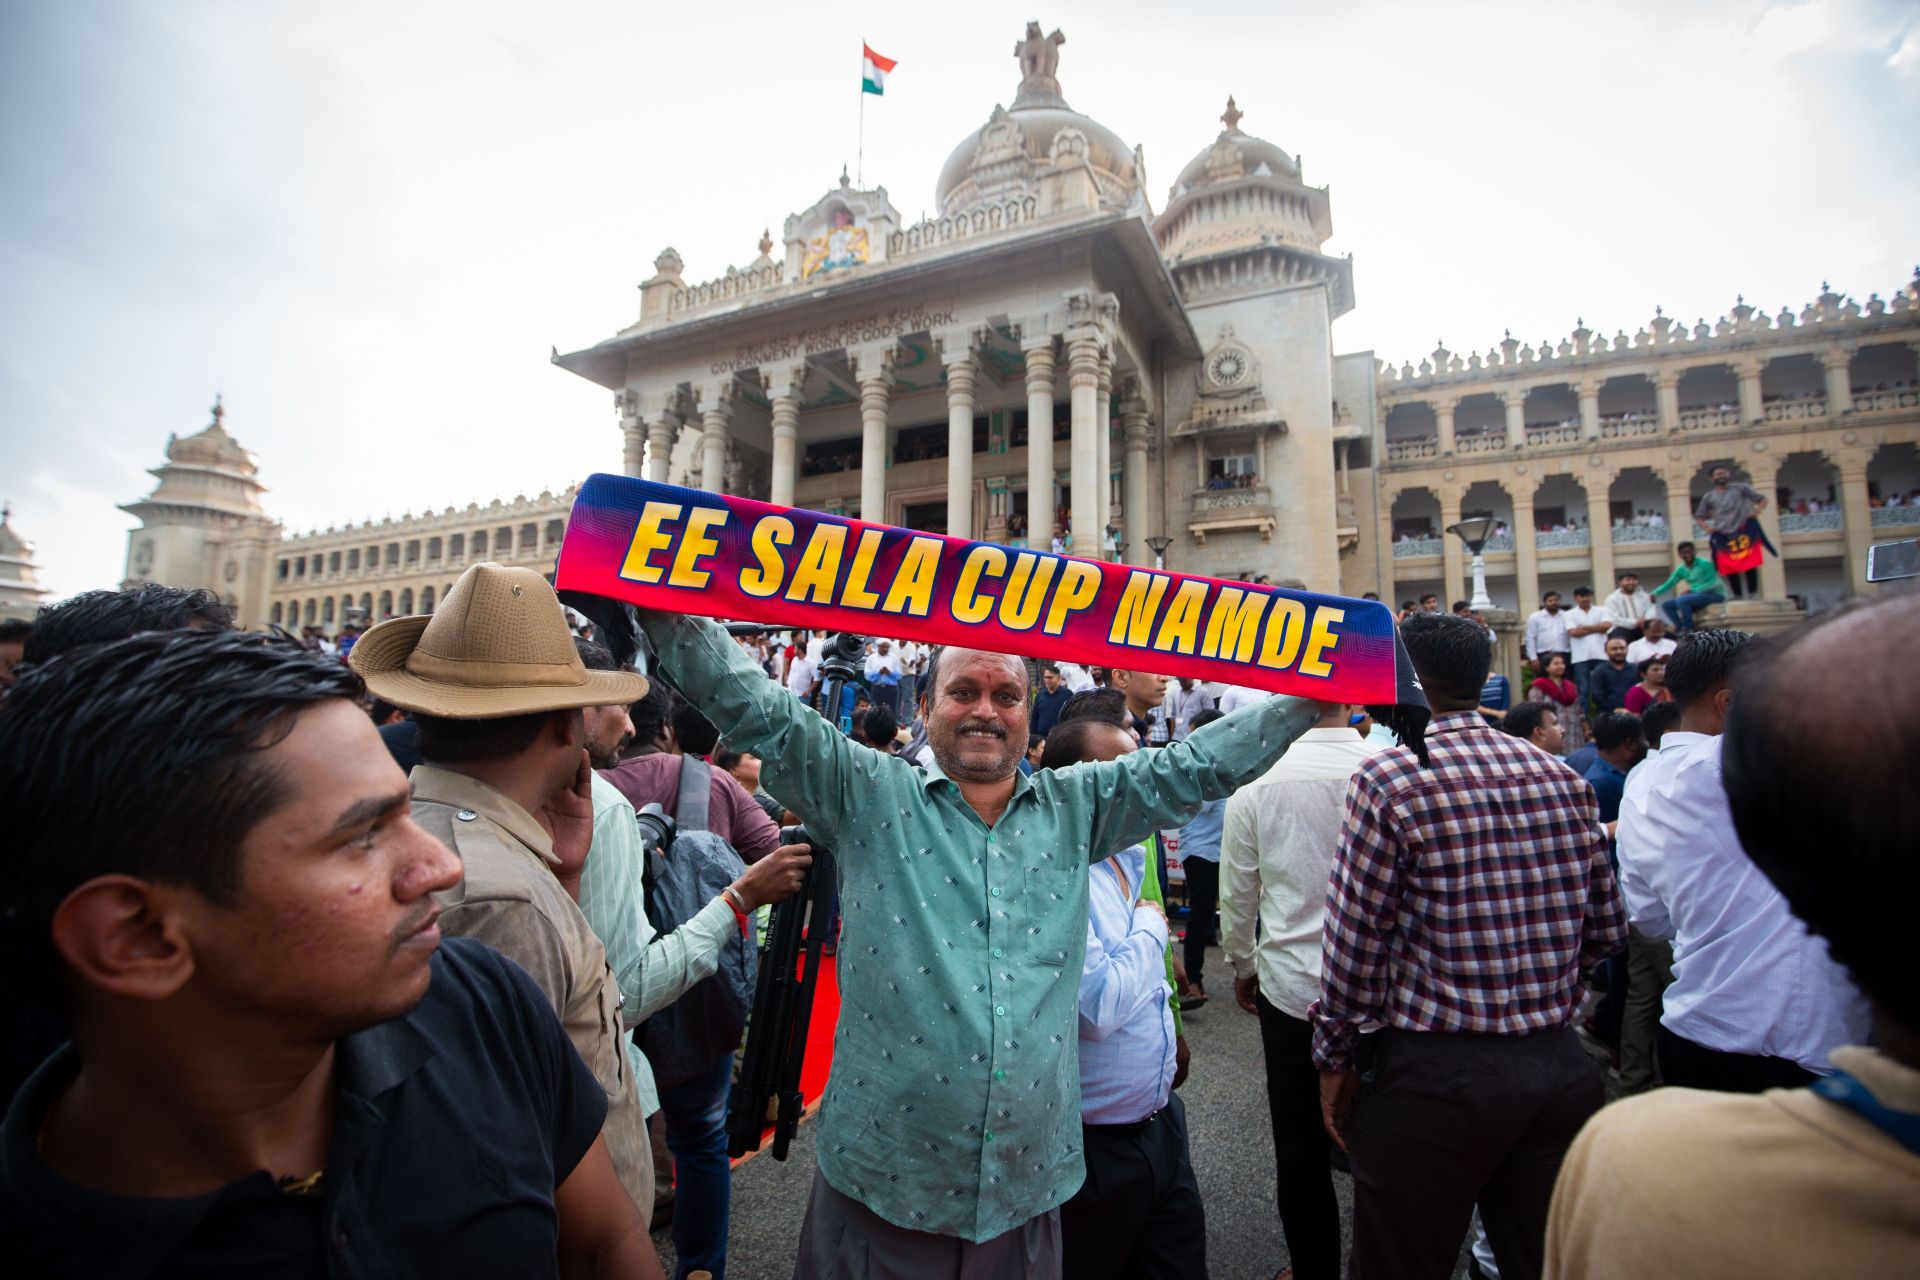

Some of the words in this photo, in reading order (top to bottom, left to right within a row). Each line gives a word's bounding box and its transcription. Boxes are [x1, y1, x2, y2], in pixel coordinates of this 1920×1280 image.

[711, 345, 799, 375] GOVERNMENT
[805, 335, 843, 353] WORK
[846, 331, 859, 347] IS
[862, 321, 905, 342] GOD'S
[618, 500, 730, 589] EE
[738, 514, 945, 618] SALA
[950, 545, 1103, 636] CUP
[1107, 570, 1345, 678] NAMDE
